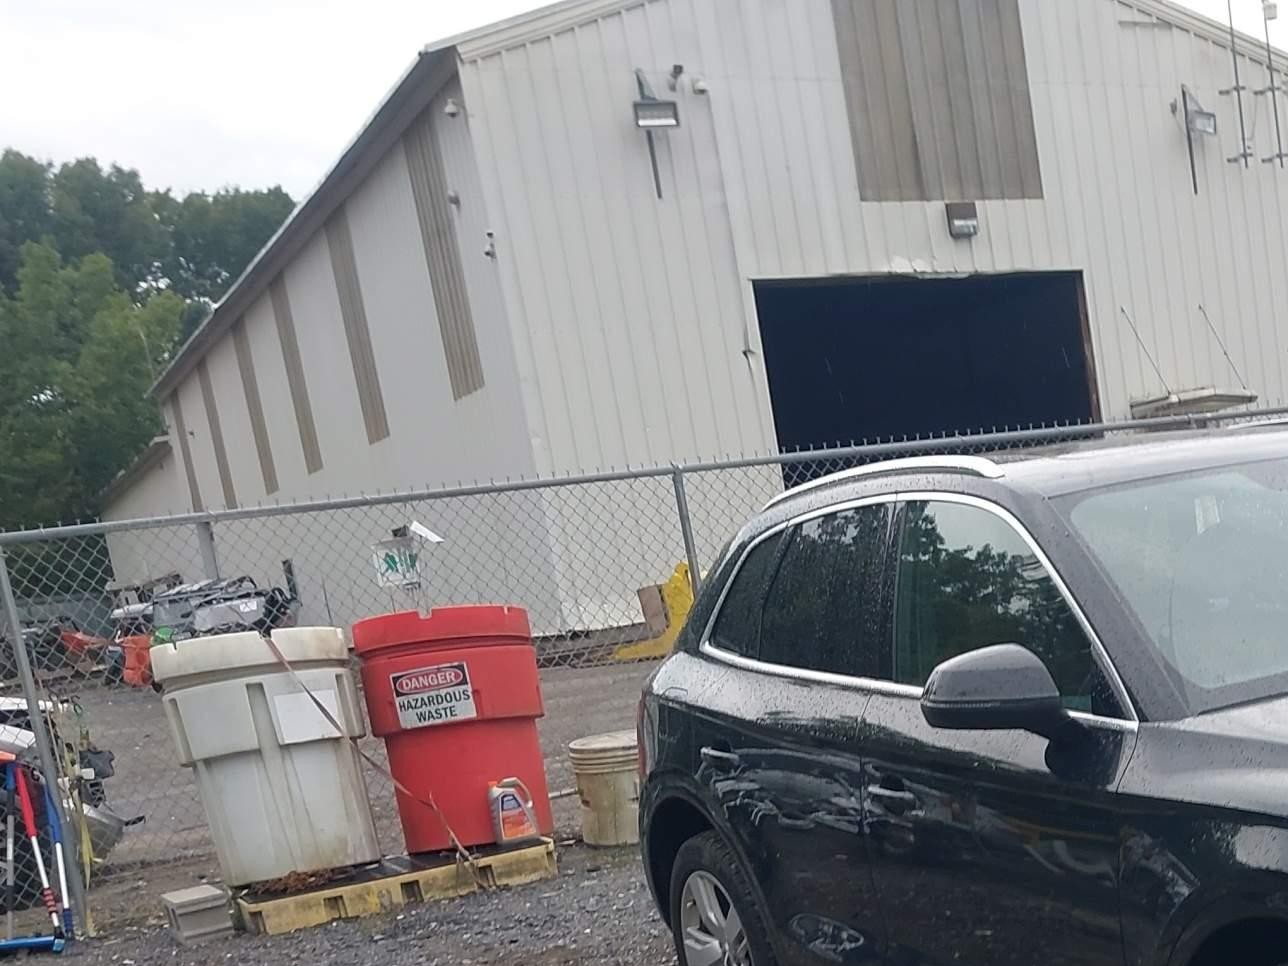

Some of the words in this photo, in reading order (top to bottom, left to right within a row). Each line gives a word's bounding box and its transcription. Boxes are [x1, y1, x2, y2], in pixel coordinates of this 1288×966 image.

[402, 671, 455, 690] DANGER
[398, 689, 470, 713] HAZARDOUS
[416, 705, 458, 723] WASTE
